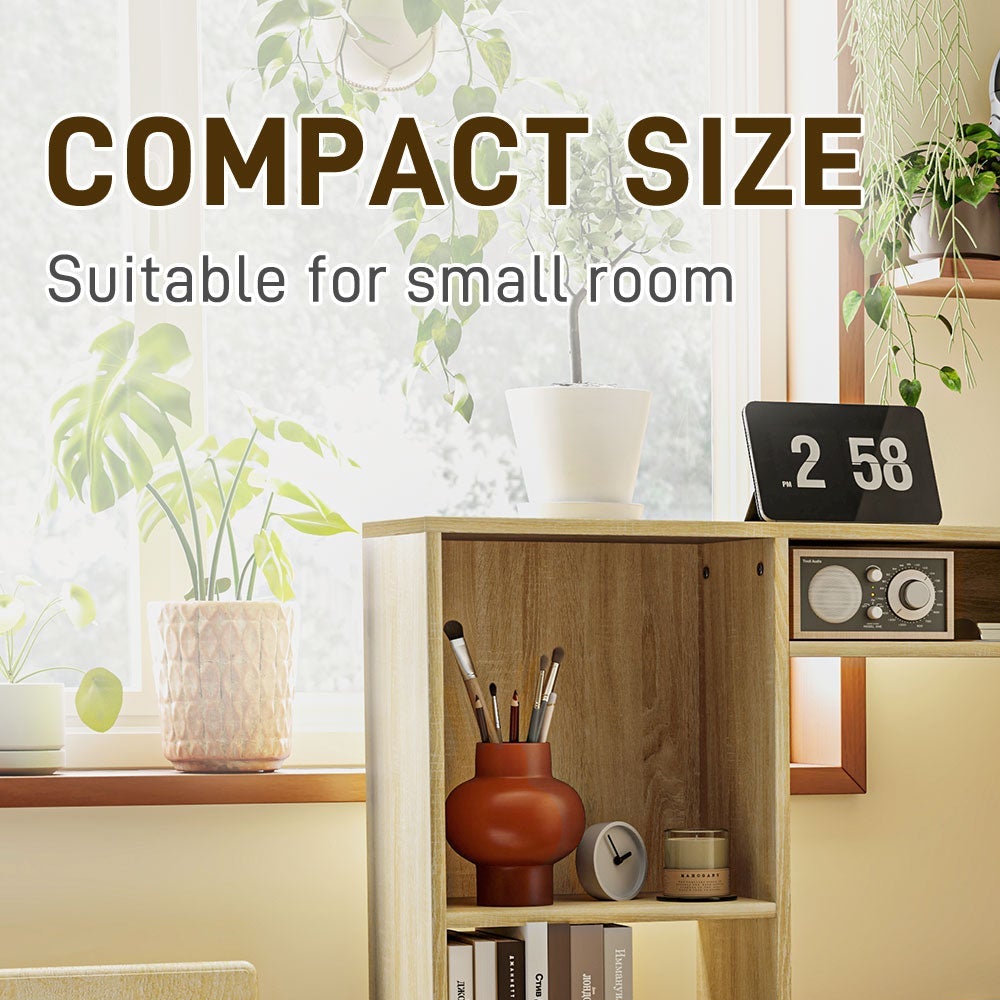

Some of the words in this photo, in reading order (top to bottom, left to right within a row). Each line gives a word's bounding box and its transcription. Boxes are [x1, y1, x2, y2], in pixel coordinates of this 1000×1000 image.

[790, 434, 827, 489] 2
[848, 437, 914, 491] 58
[535, 973, 544, 998] Стив
